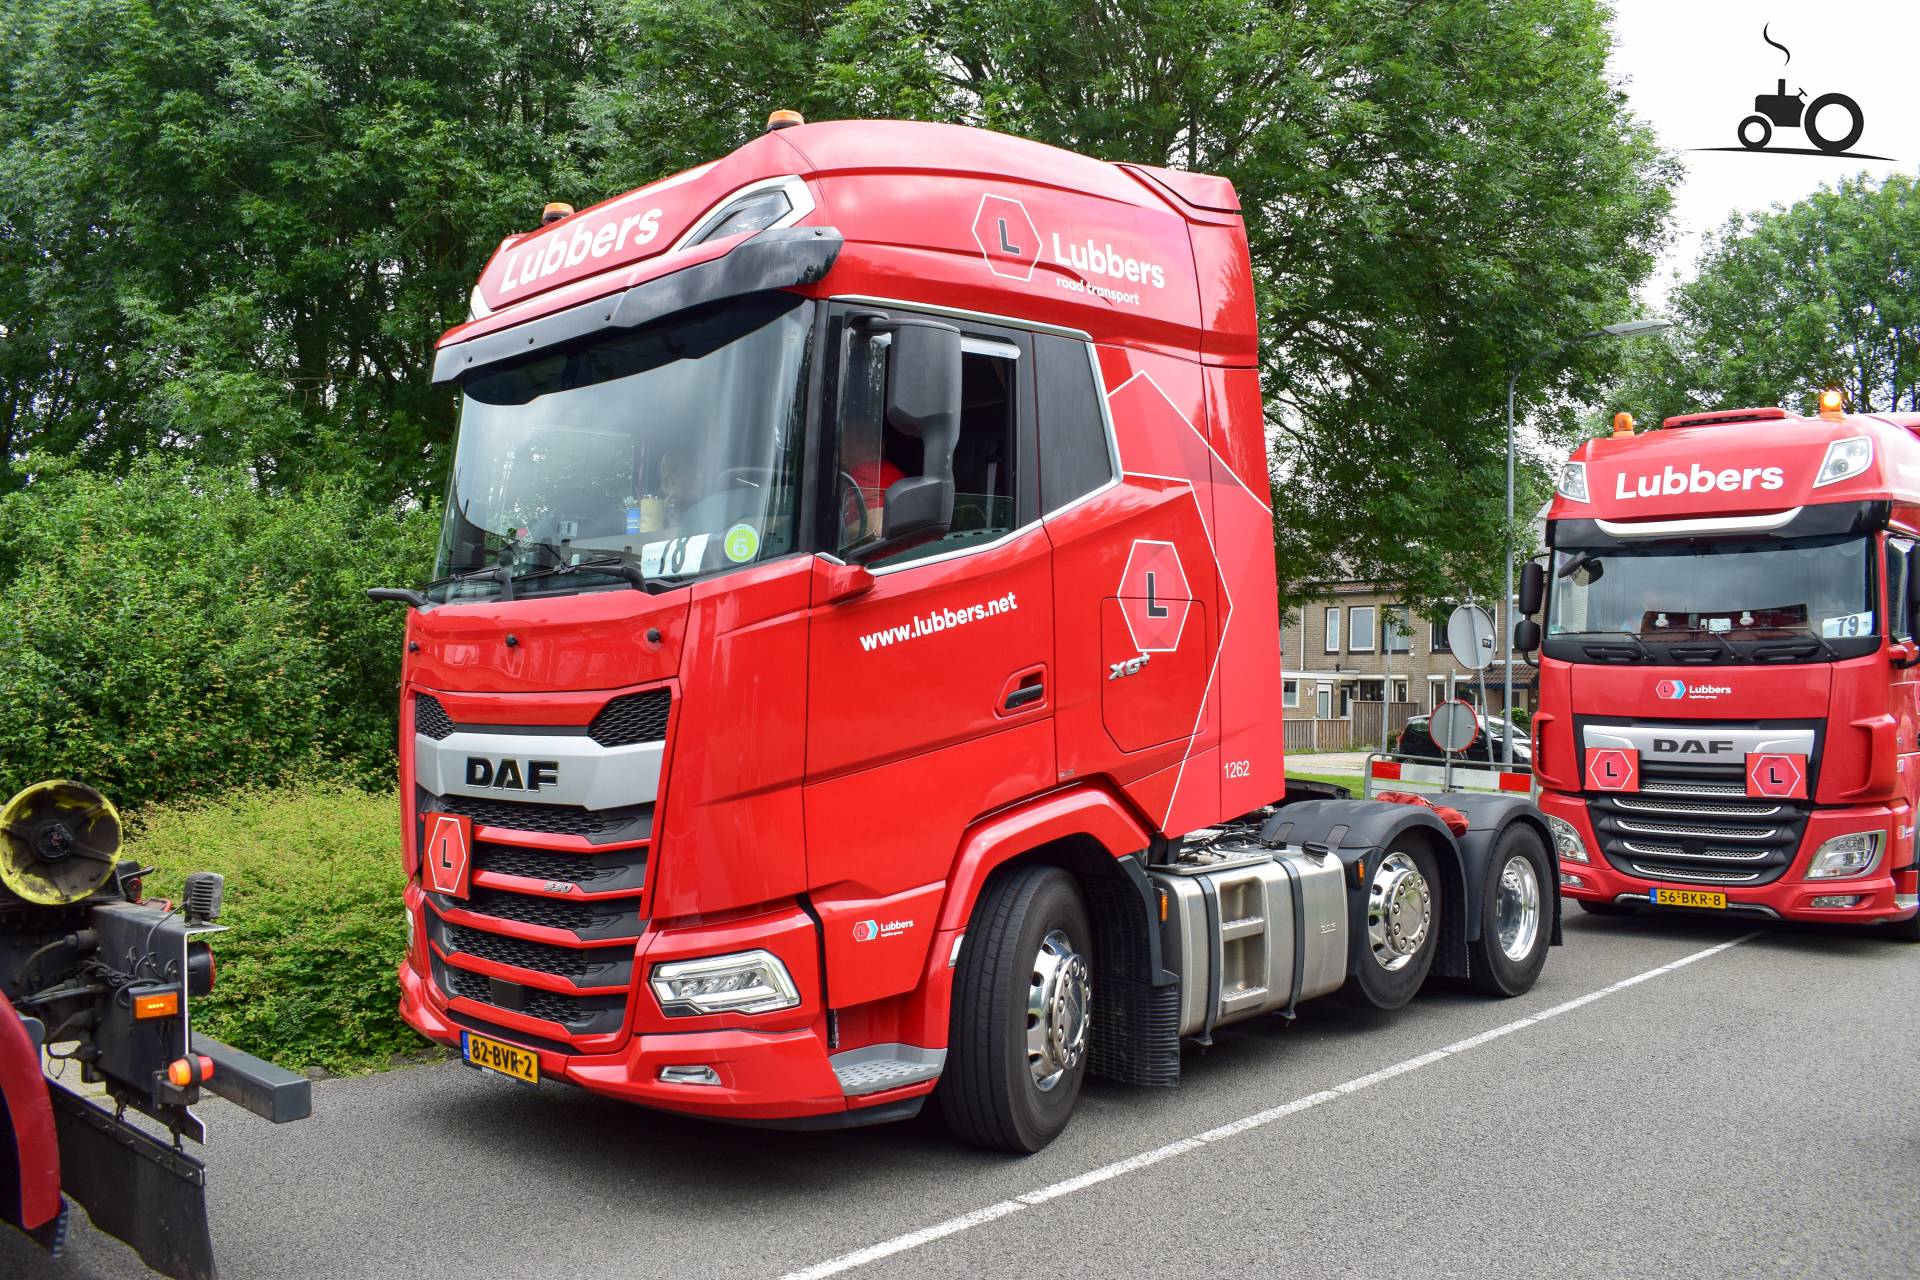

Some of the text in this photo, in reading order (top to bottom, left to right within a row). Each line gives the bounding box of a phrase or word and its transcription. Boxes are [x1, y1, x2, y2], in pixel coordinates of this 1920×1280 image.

[499, 208, 663, 294] Lubbers
[998, 218, 1021, 256] L
[1052, 232, 1166, 289] Lubbers
[1056, 277, 1140, 305] road transport
[1615, 463, 1784, 500] Lubbers
[733, 538, 749, 556] 6
[1146, 571, 1169, 619] L
[860, 591, 1018, 652] www.lubbers.net
[1837, 615, 1859, 637] 79
[1689, 685, 1732, 694] Lubbers
[1653, 739, 1733, 754] DAF
[465, 756, 560, 793] DAF
[1224, 760, 1250, 779] 1262
[1606, 761, 1618, 777] L
[1768, 766, 1783, 784] L
[442, 837, 452, 869] L
[880, 920, 914, 932] Lubbers
[472, 1039, 532, 1078] 82-BVR-2
